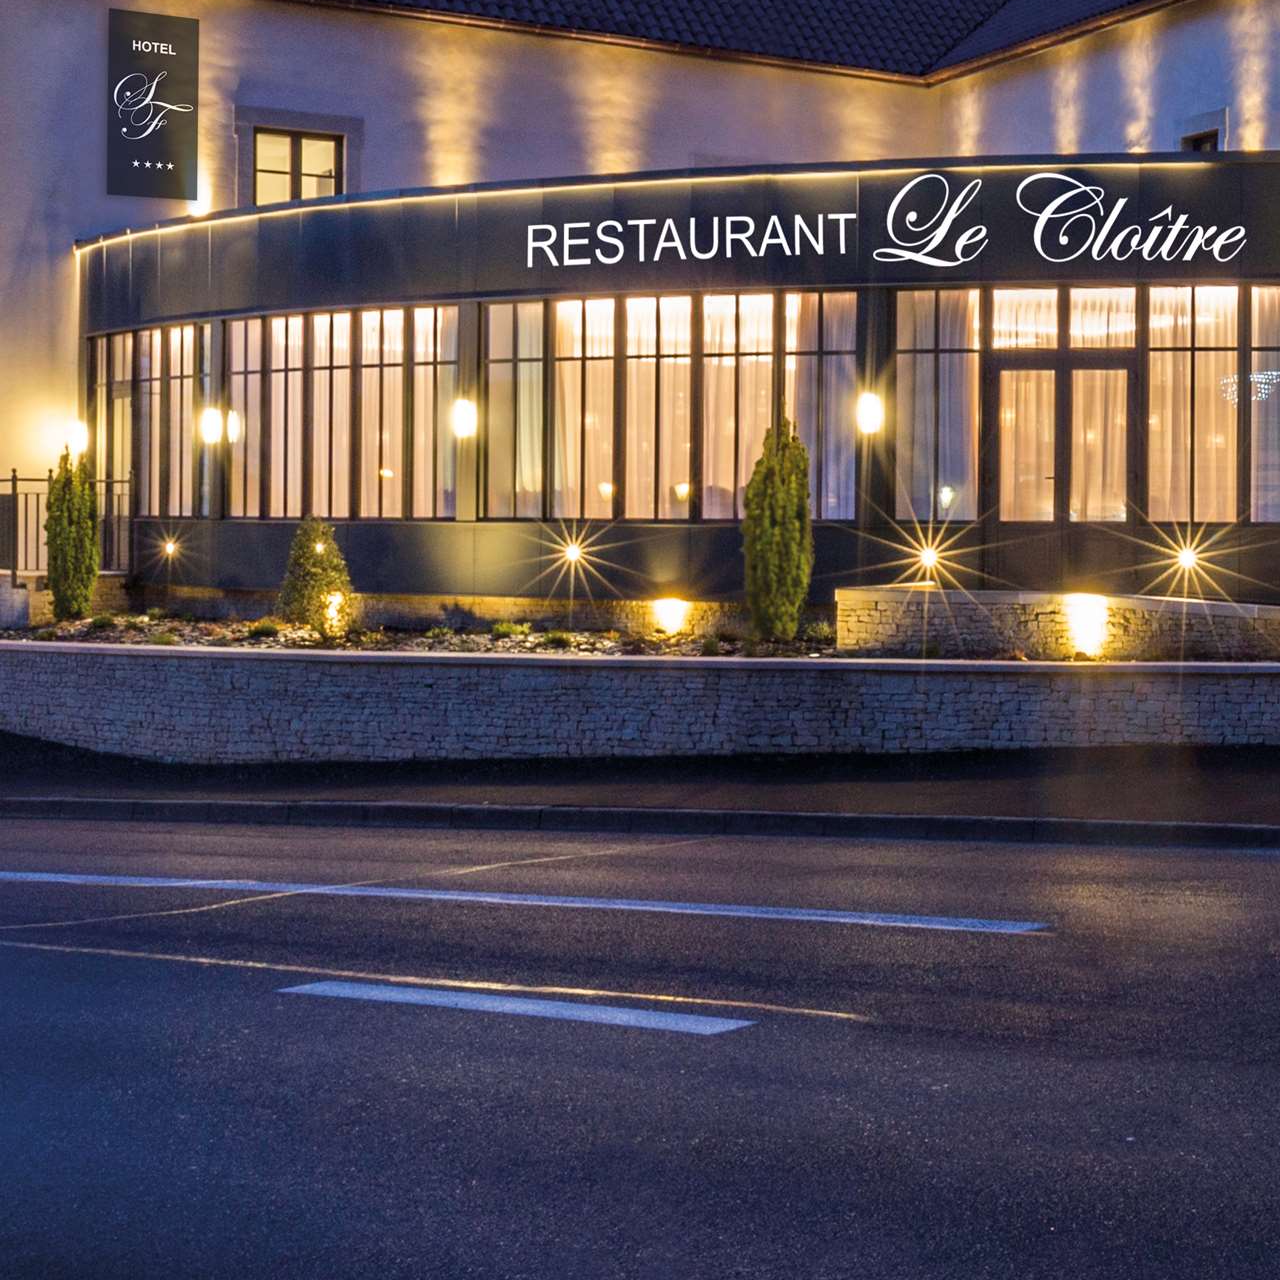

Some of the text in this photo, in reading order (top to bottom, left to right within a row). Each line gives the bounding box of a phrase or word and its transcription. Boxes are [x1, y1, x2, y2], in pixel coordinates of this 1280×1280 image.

[132, 40, 176, 56] HOTEL
[527, 172, 1247, 268] RESTAURANT Le Cloître
